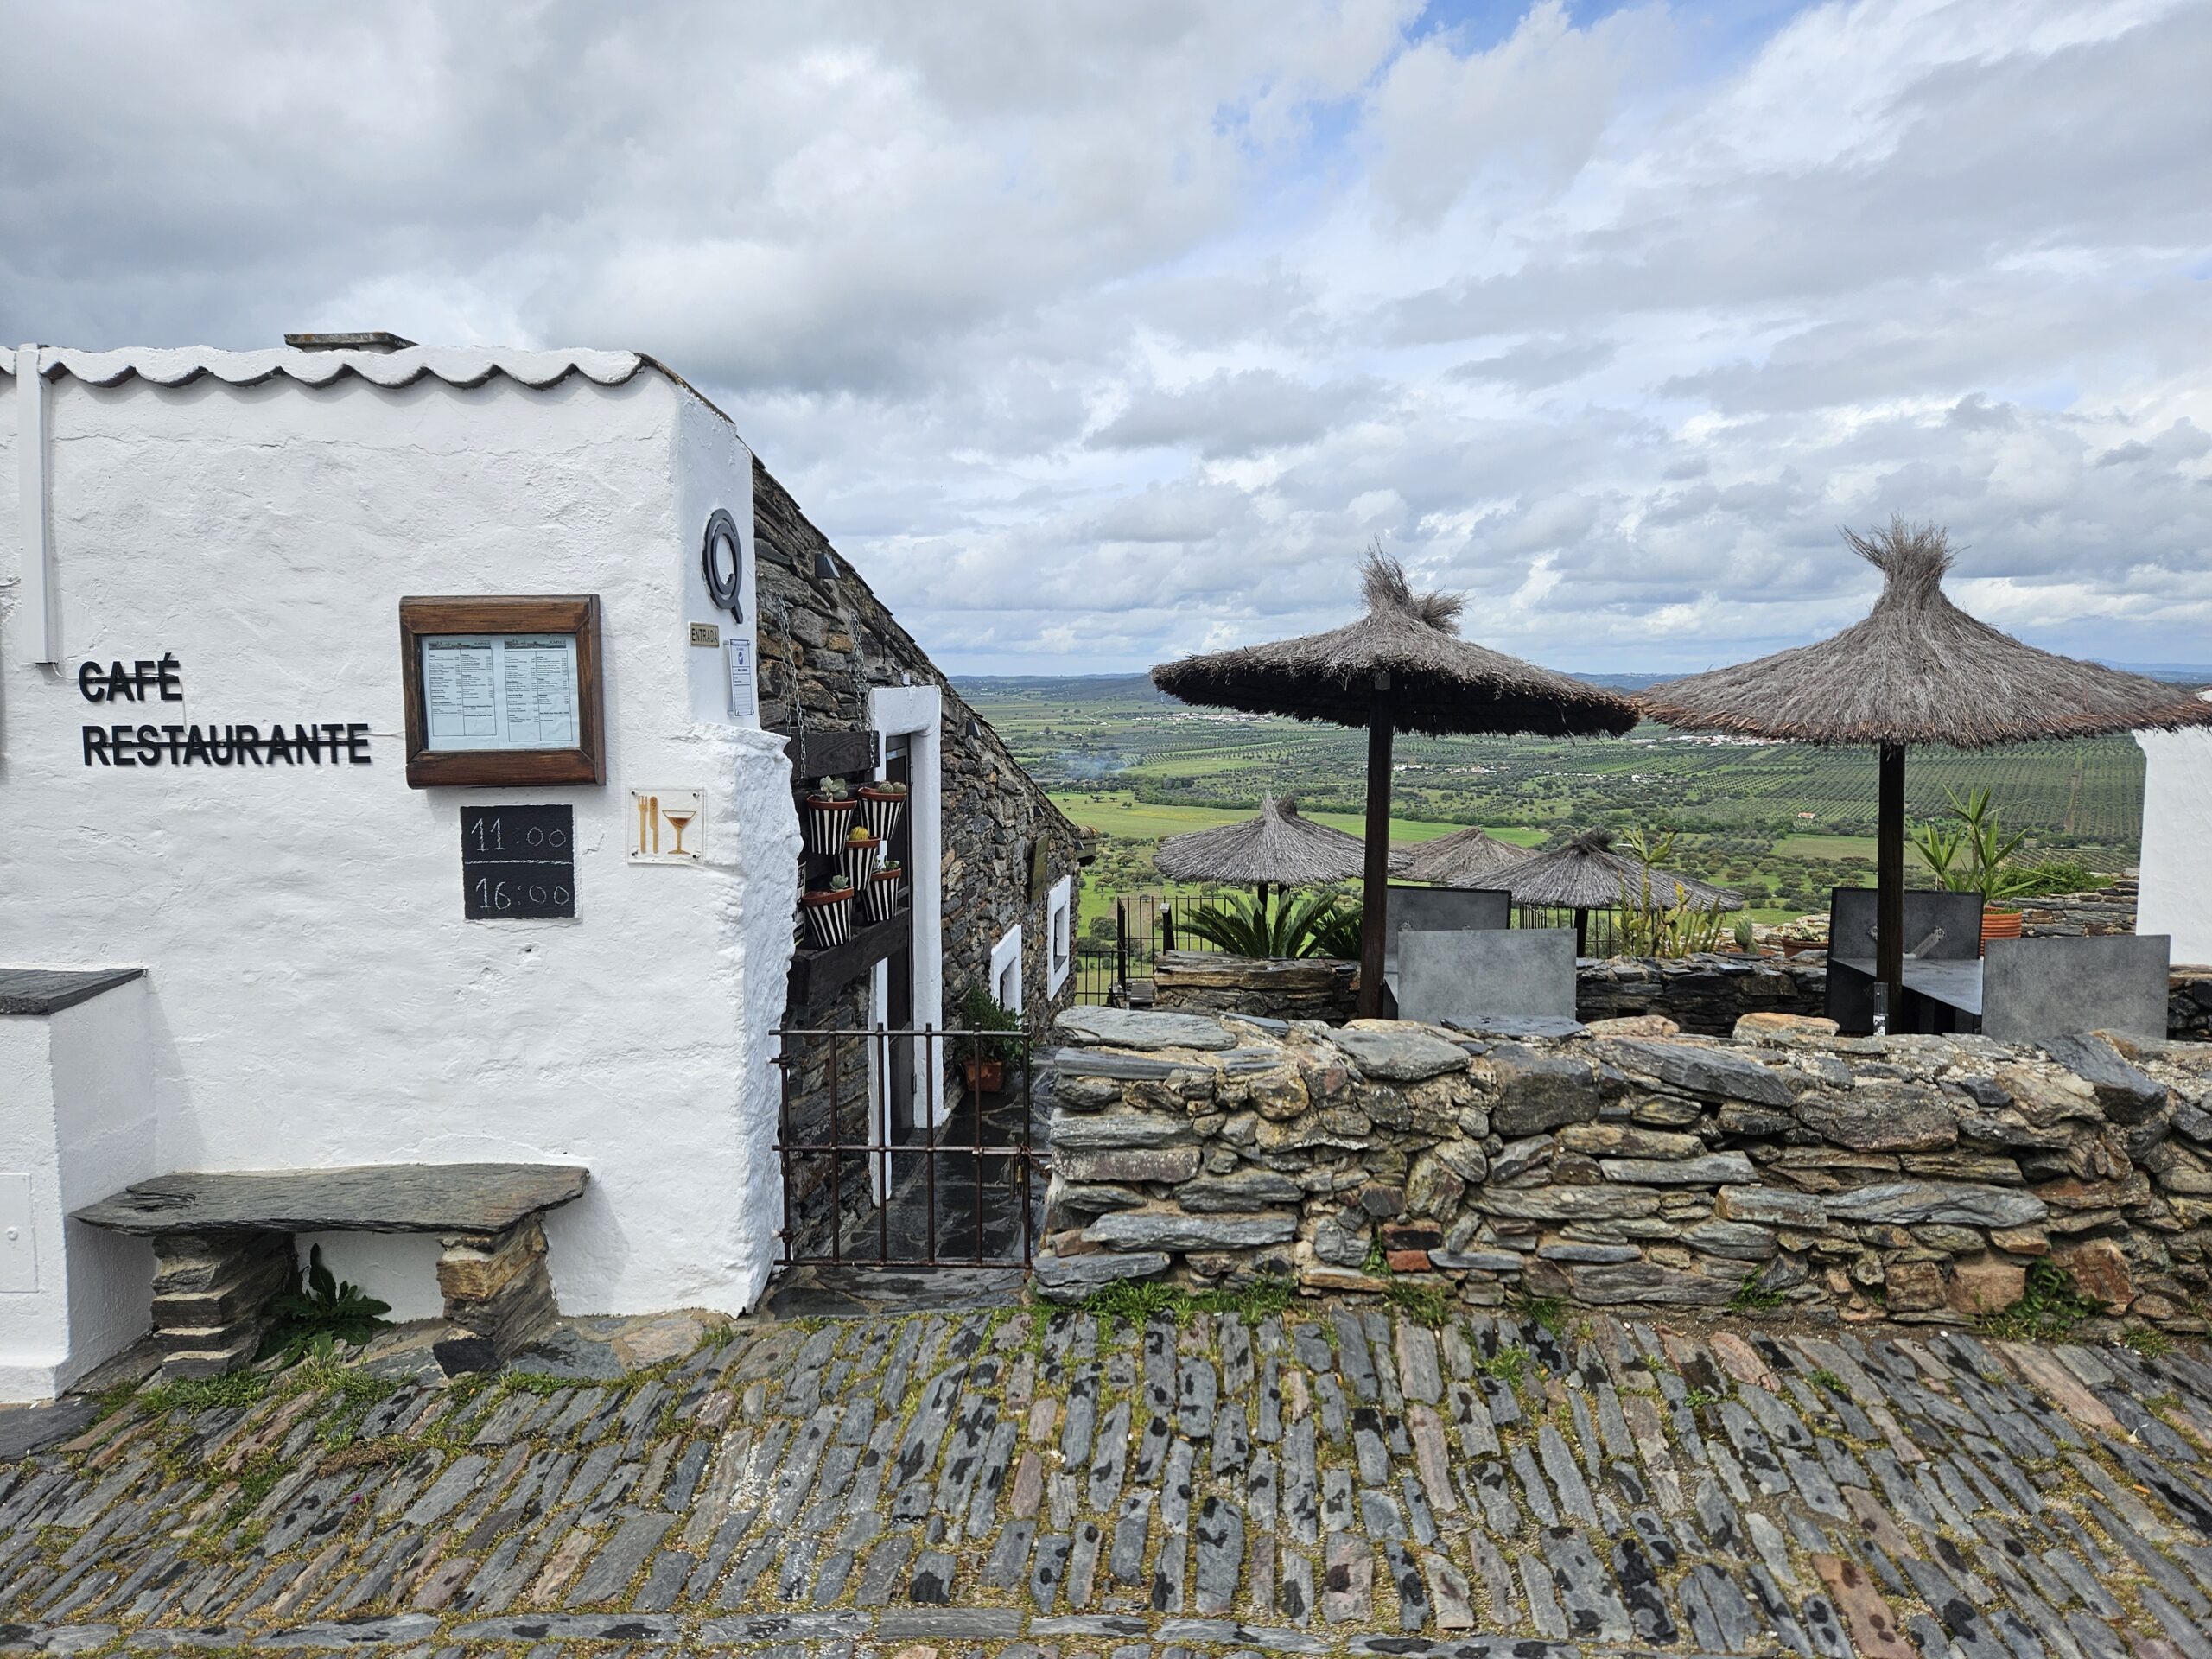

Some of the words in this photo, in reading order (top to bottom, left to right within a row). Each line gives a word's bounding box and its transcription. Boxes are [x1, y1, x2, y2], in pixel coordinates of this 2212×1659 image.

[691, 627, 718, 644] ENTRADA
[79, 652, 182, 702] CAFÉ
[82, 723, 372, 766] RESTAURANTE
[471, 817, 567, 851] 11:00
[476, 877, 570, 910] 16:00
